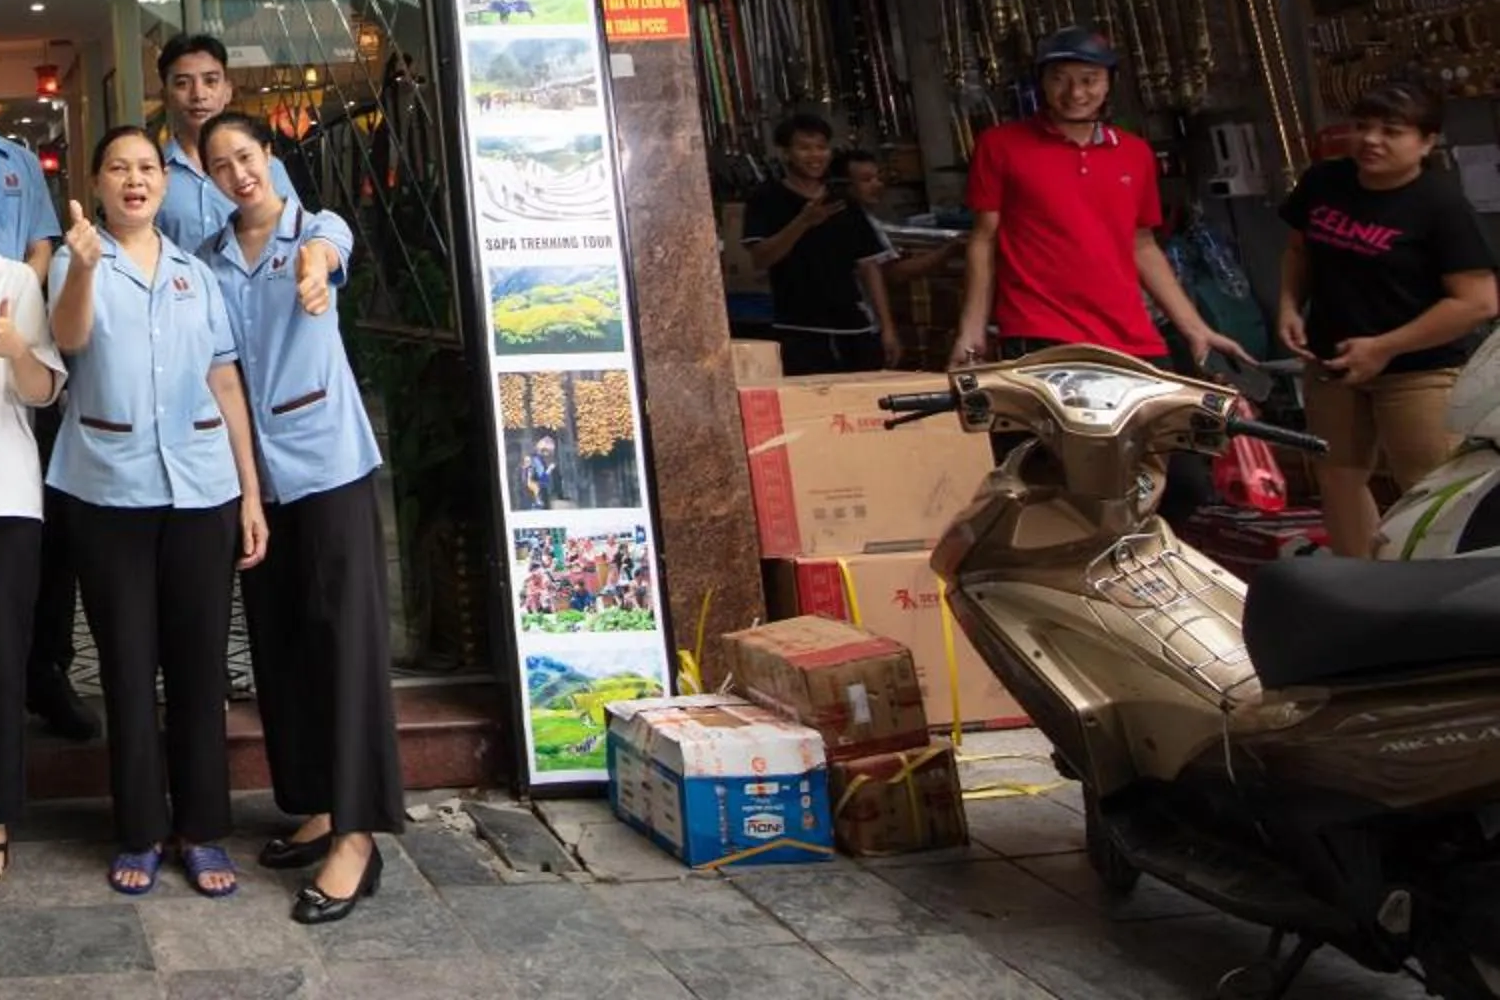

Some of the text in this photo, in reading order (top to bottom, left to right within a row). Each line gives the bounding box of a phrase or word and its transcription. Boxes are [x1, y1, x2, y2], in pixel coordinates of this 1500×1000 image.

[485, 235, 614, 251] SAPA TREKKING TOUR
